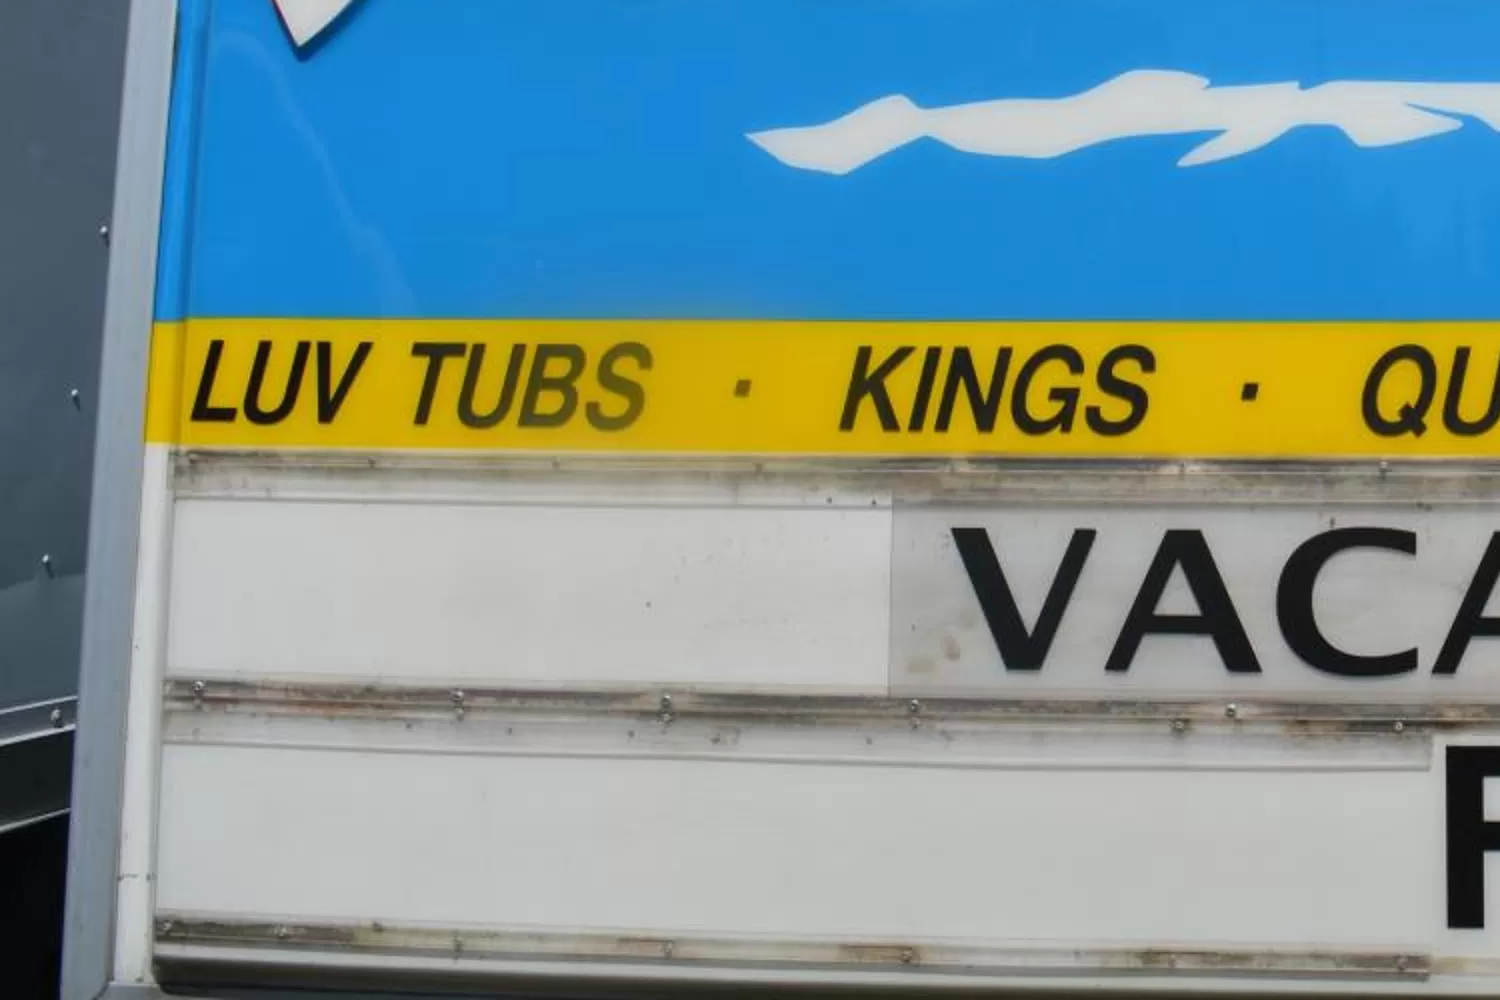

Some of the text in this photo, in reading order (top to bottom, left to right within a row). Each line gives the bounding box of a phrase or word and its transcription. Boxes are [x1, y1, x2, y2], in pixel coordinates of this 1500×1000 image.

[190, 340, 373, 425] LUV
[410, 341, 654, 431] TUBS
[838, 343, 1156, 436] KINGS
